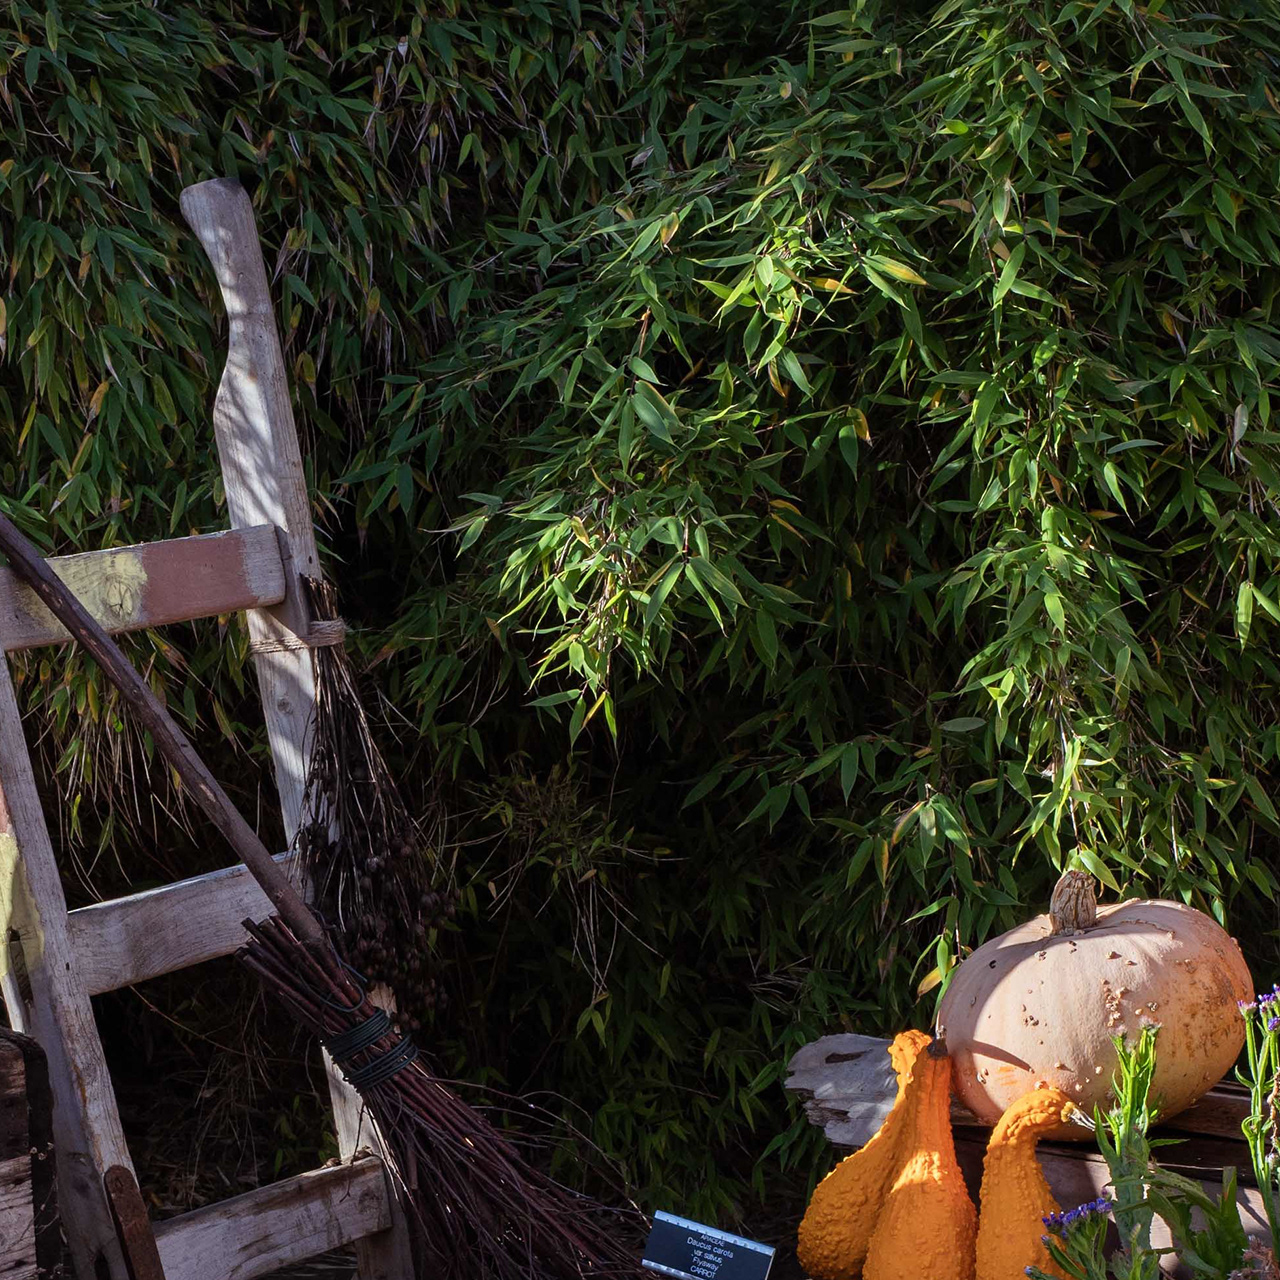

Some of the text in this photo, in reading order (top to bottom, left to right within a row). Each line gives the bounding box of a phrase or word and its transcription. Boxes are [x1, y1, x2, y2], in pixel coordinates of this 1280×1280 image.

[687, 1236, 734, 1259] Daucus carota
[690, 1265, 717, 1279] CARROT
